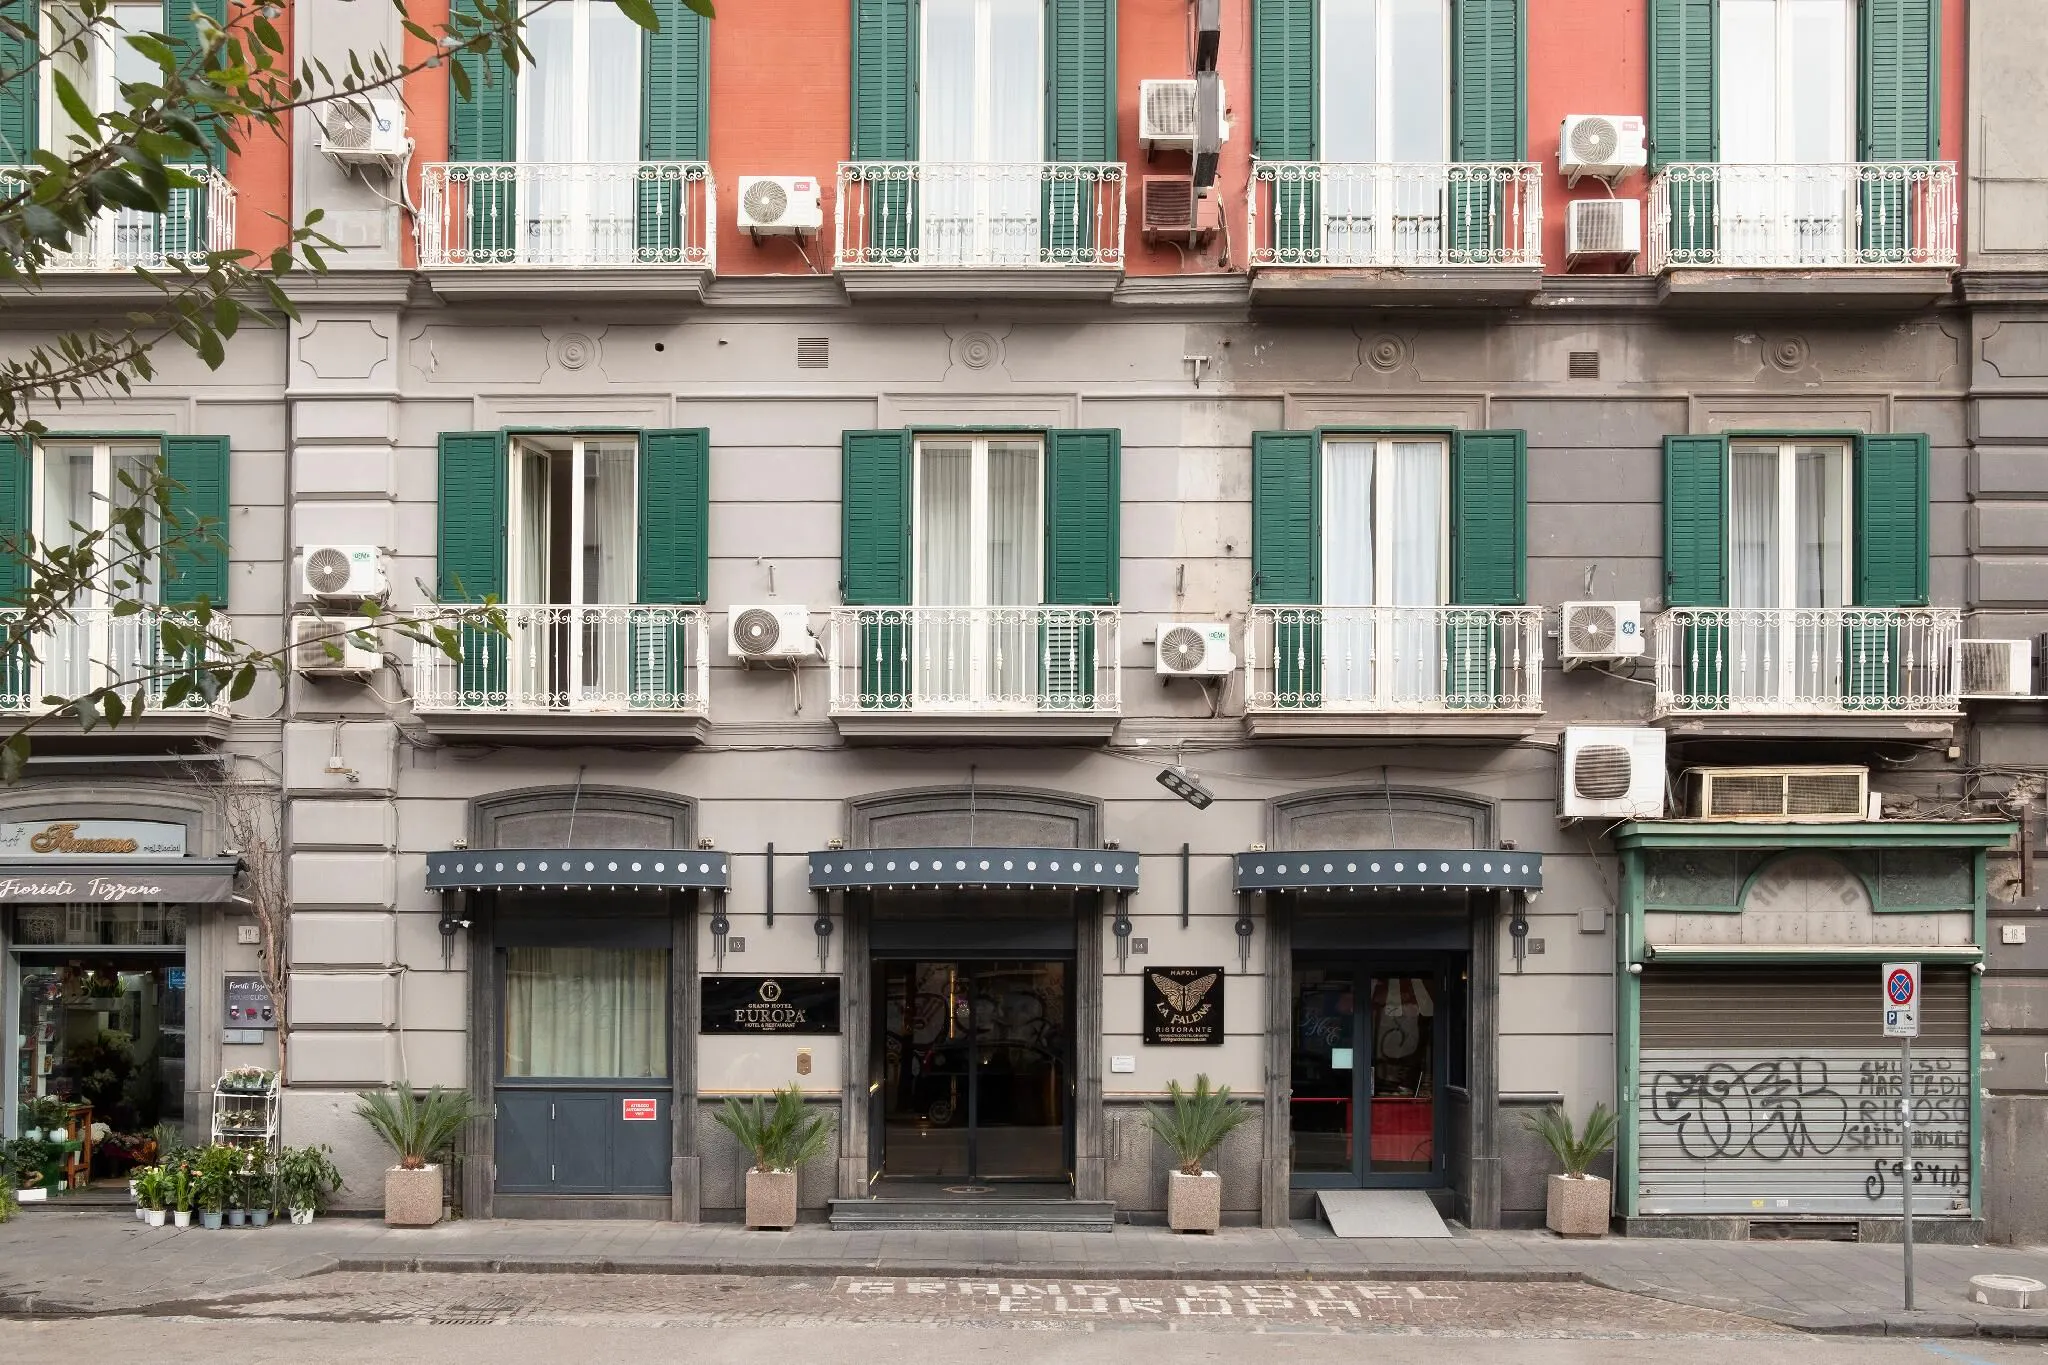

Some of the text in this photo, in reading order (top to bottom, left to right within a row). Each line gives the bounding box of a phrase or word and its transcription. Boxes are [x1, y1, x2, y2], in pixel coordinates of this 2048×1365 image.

[0, 877, 162, 900] Fioristi Tizzano
[734, 1009, 805, 1023] EUROPA
[1156, 1002, 1169, 1018] LA
[846, 1282, 1460, 1300] GRAND HOTEL
[999, 1296, 1362, 1318] EUROPA
